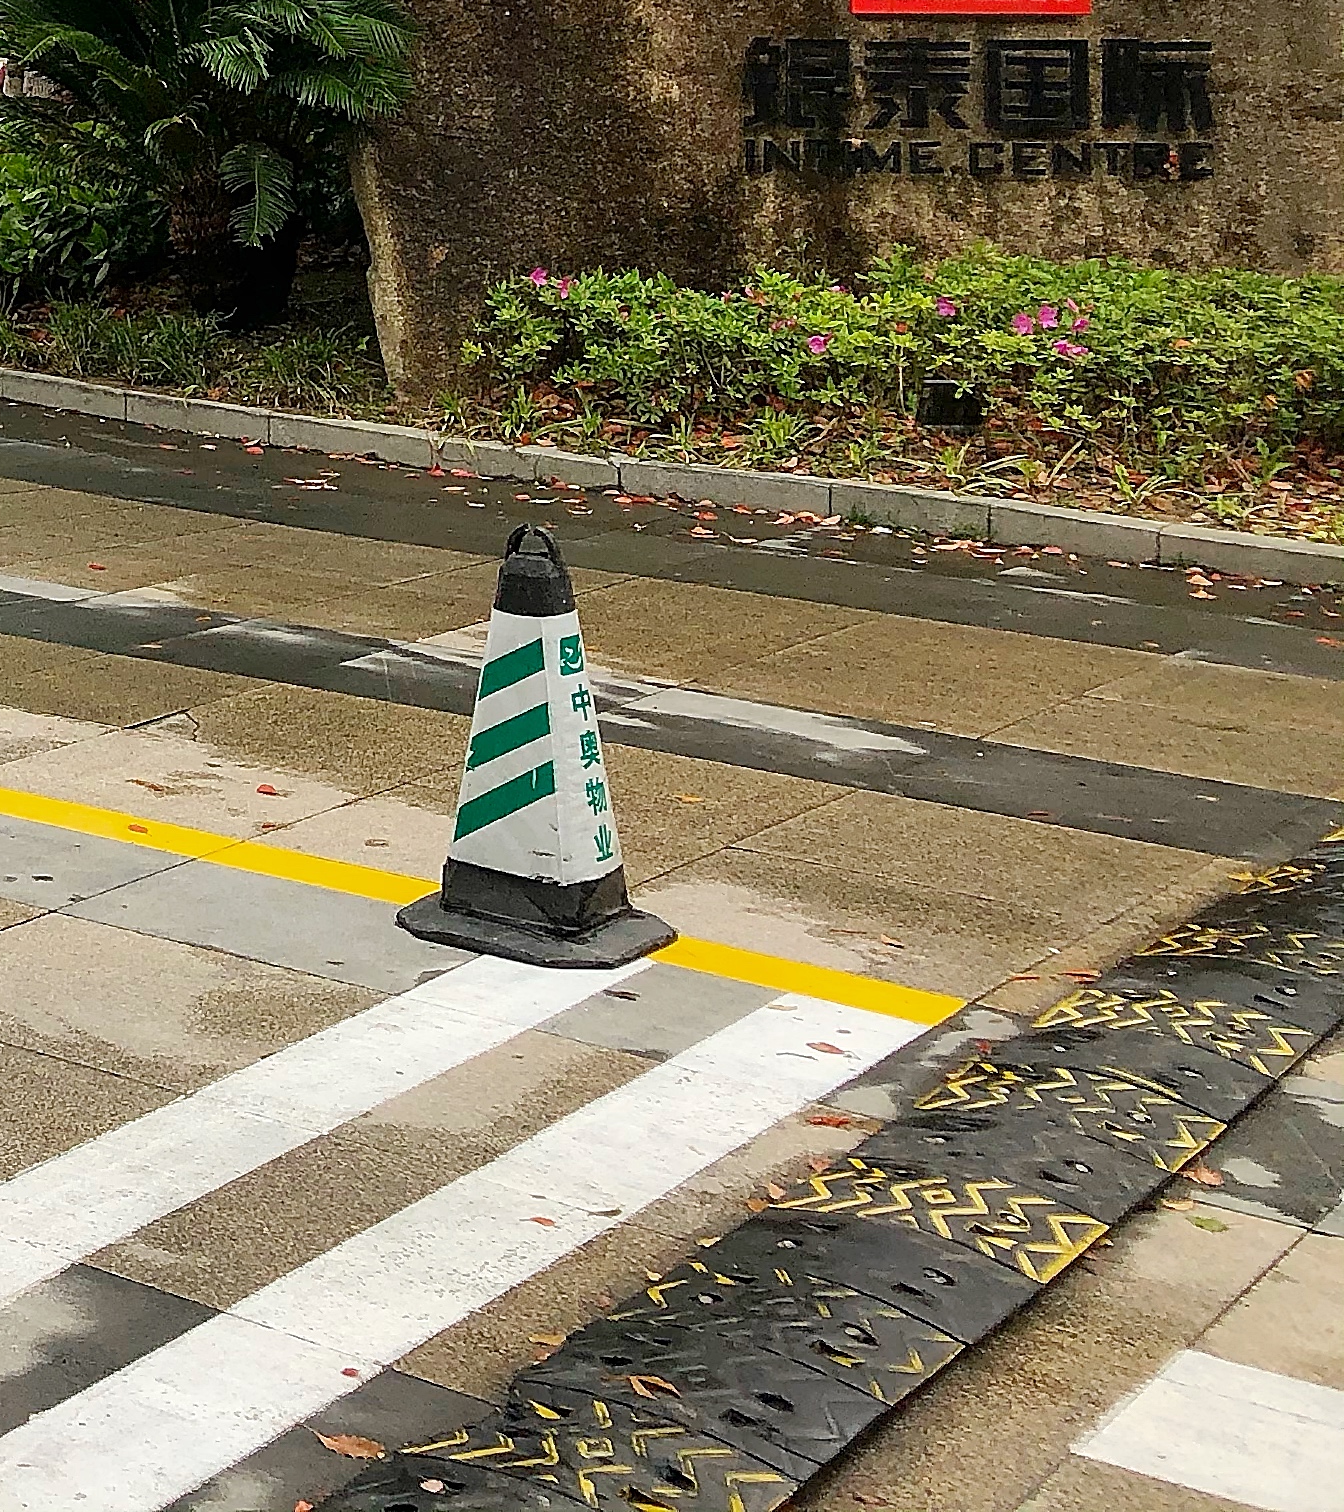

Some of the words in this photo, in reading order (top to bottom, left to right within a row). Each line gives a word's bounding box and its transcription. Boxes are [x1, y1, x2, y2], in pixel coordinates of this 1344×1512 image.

[969, 140, 1214, 180] CENTRE
[570, 683, 615, 862] 中奥物业
